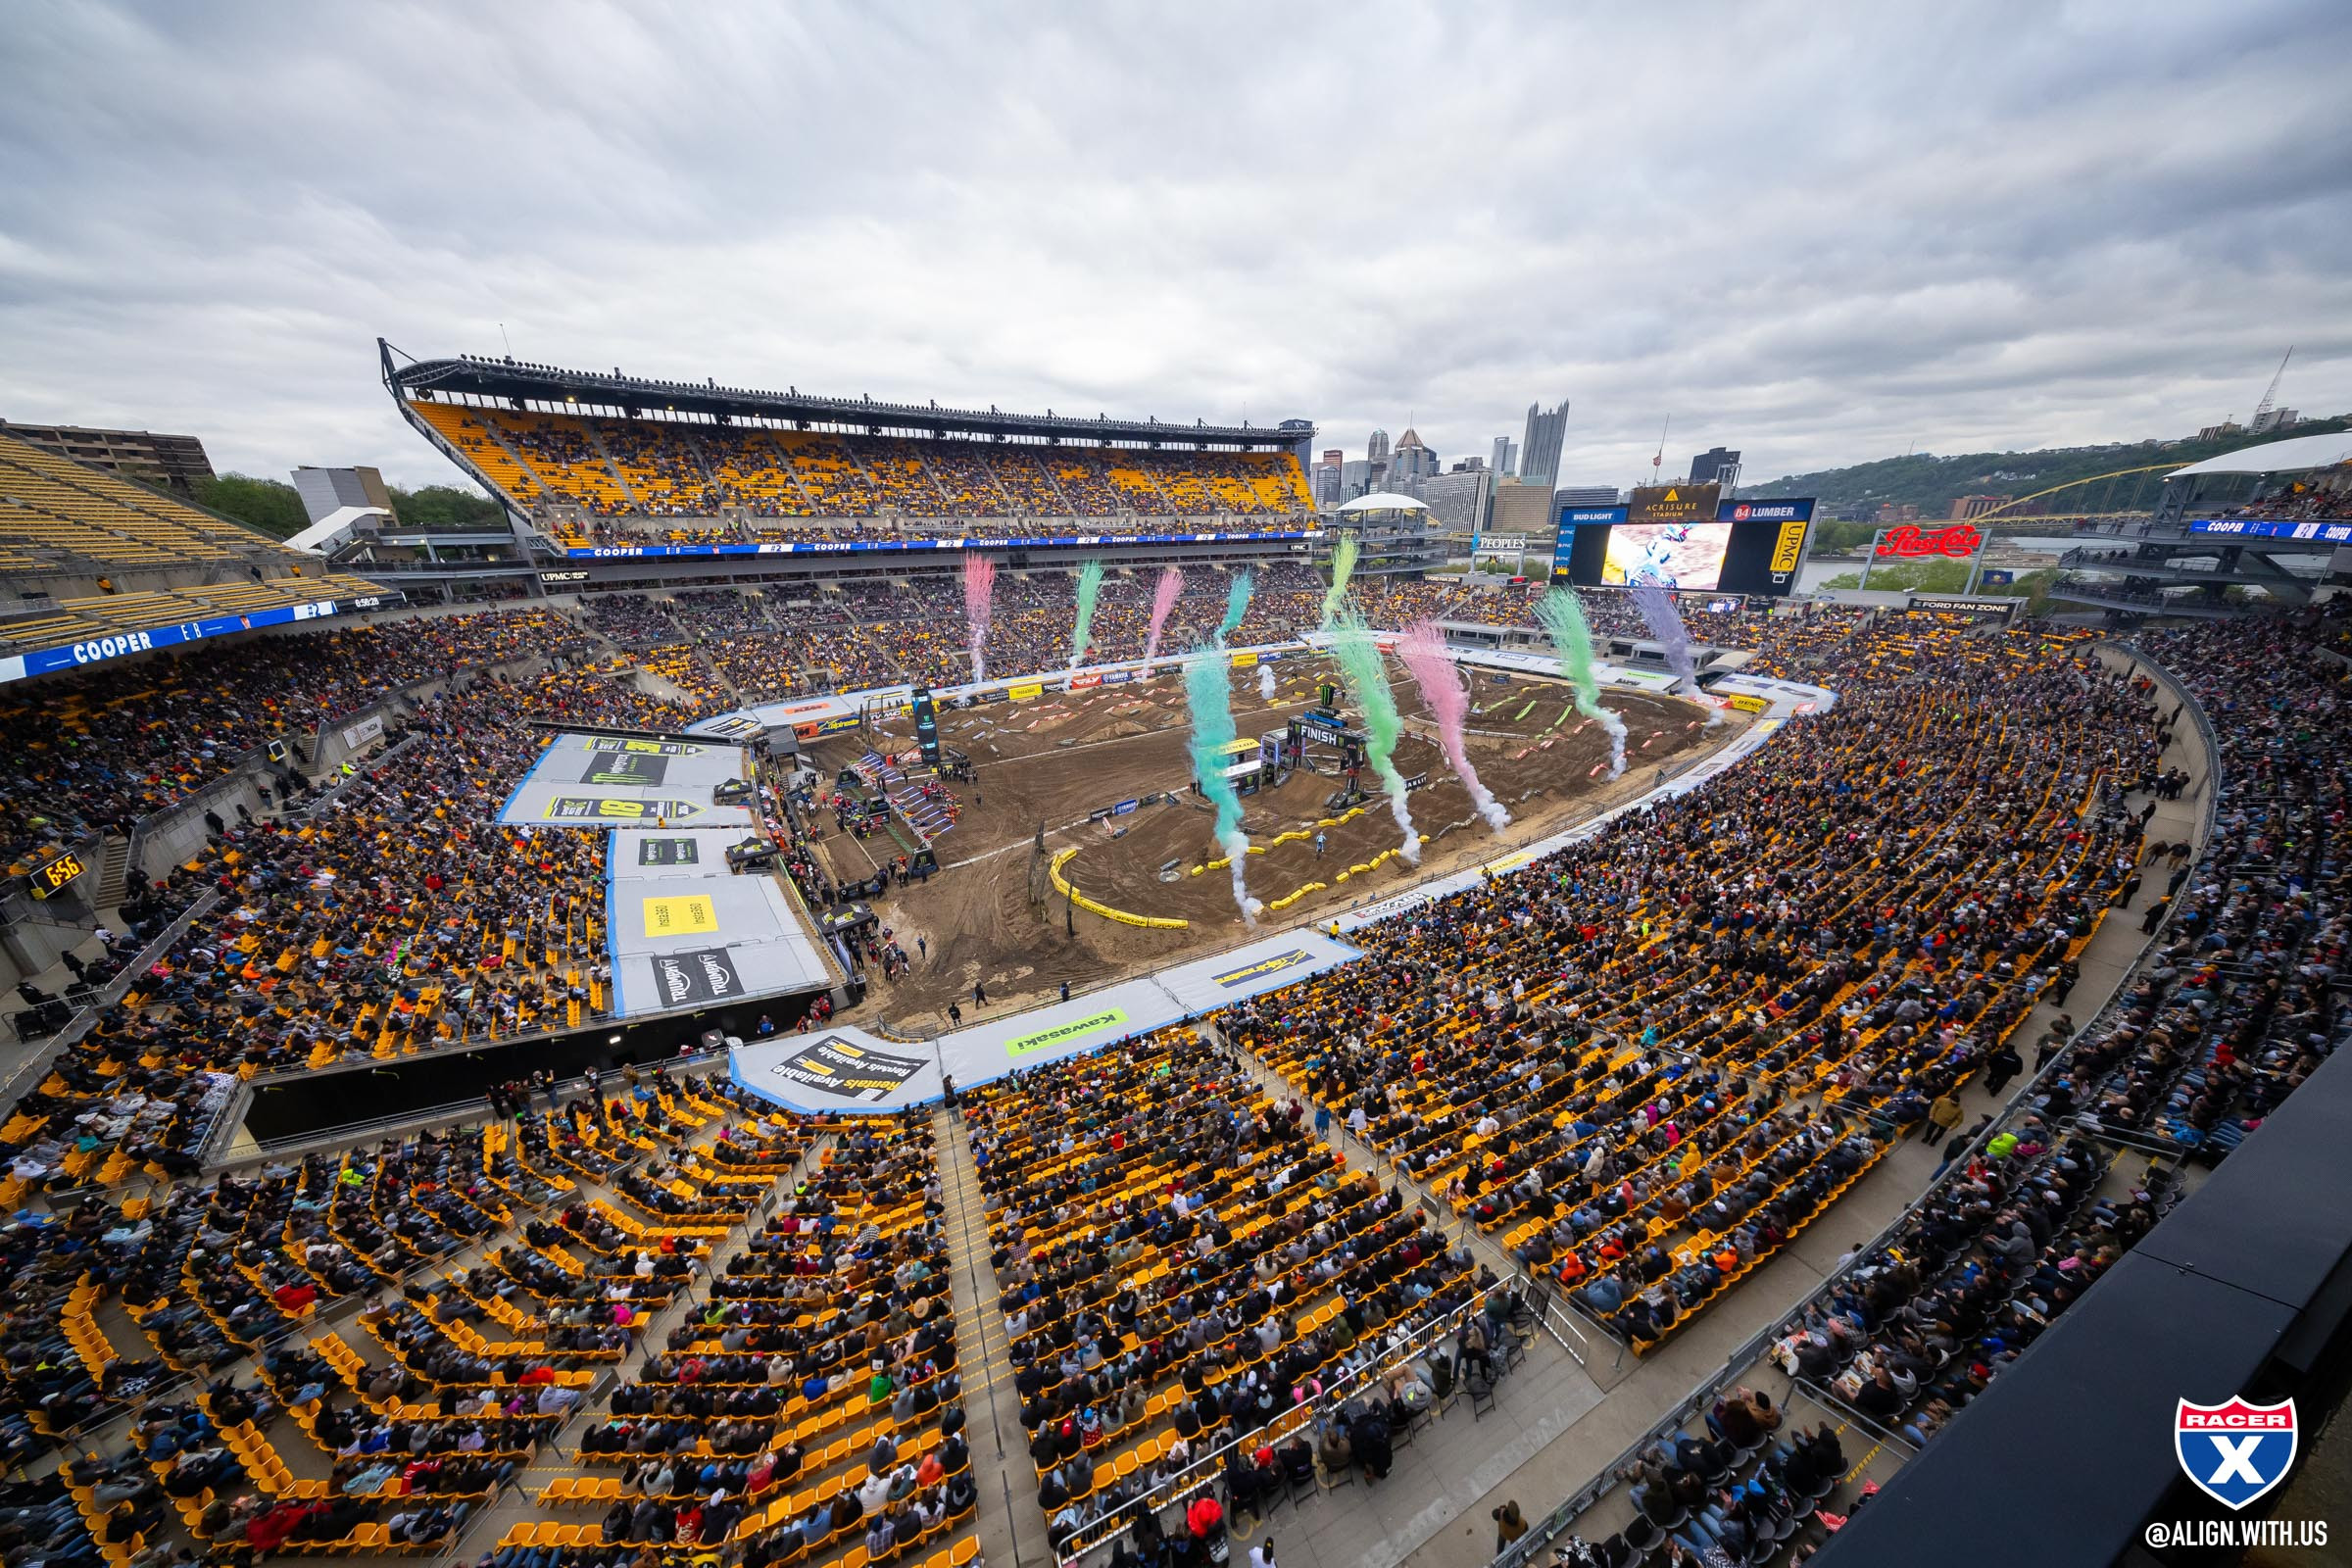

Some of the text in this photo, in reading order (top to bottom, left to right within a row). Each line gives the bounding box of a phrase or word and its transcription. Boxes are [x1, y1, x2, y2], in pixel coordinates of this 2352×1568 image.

[1645, 503, 1697, 512] ACRISURE
[1751, 507, 1794, 517] LUMBER
[2207, 522, 2244, 533] COOPER
[594, 548, 643, 557] COOPER
[1480, 537, 1525, 549] PEOPLES
[1779, 525, 1803, 568] UPMC
[541, 572, 570, 581] UPMC
[74, 632, 153, 663] COOPER
[1300, 725, 1337, 746] FINISH
[599, 800, 645, 817] 18
[45, 856, 79, 887] 6:56
[1115, 915, 1145, 925] DUNLOP
[664, 965, 691, 1003] TRIUMPH
[703, 960, 730, 996] TRIUMPH
[1017, 1014, 1116, 1050] Kawasaki
[817, 1047, 866, 1070] Available
[773, 1064, 845, 1088] Available
[844, 1079, 903, 1092] Rentals
